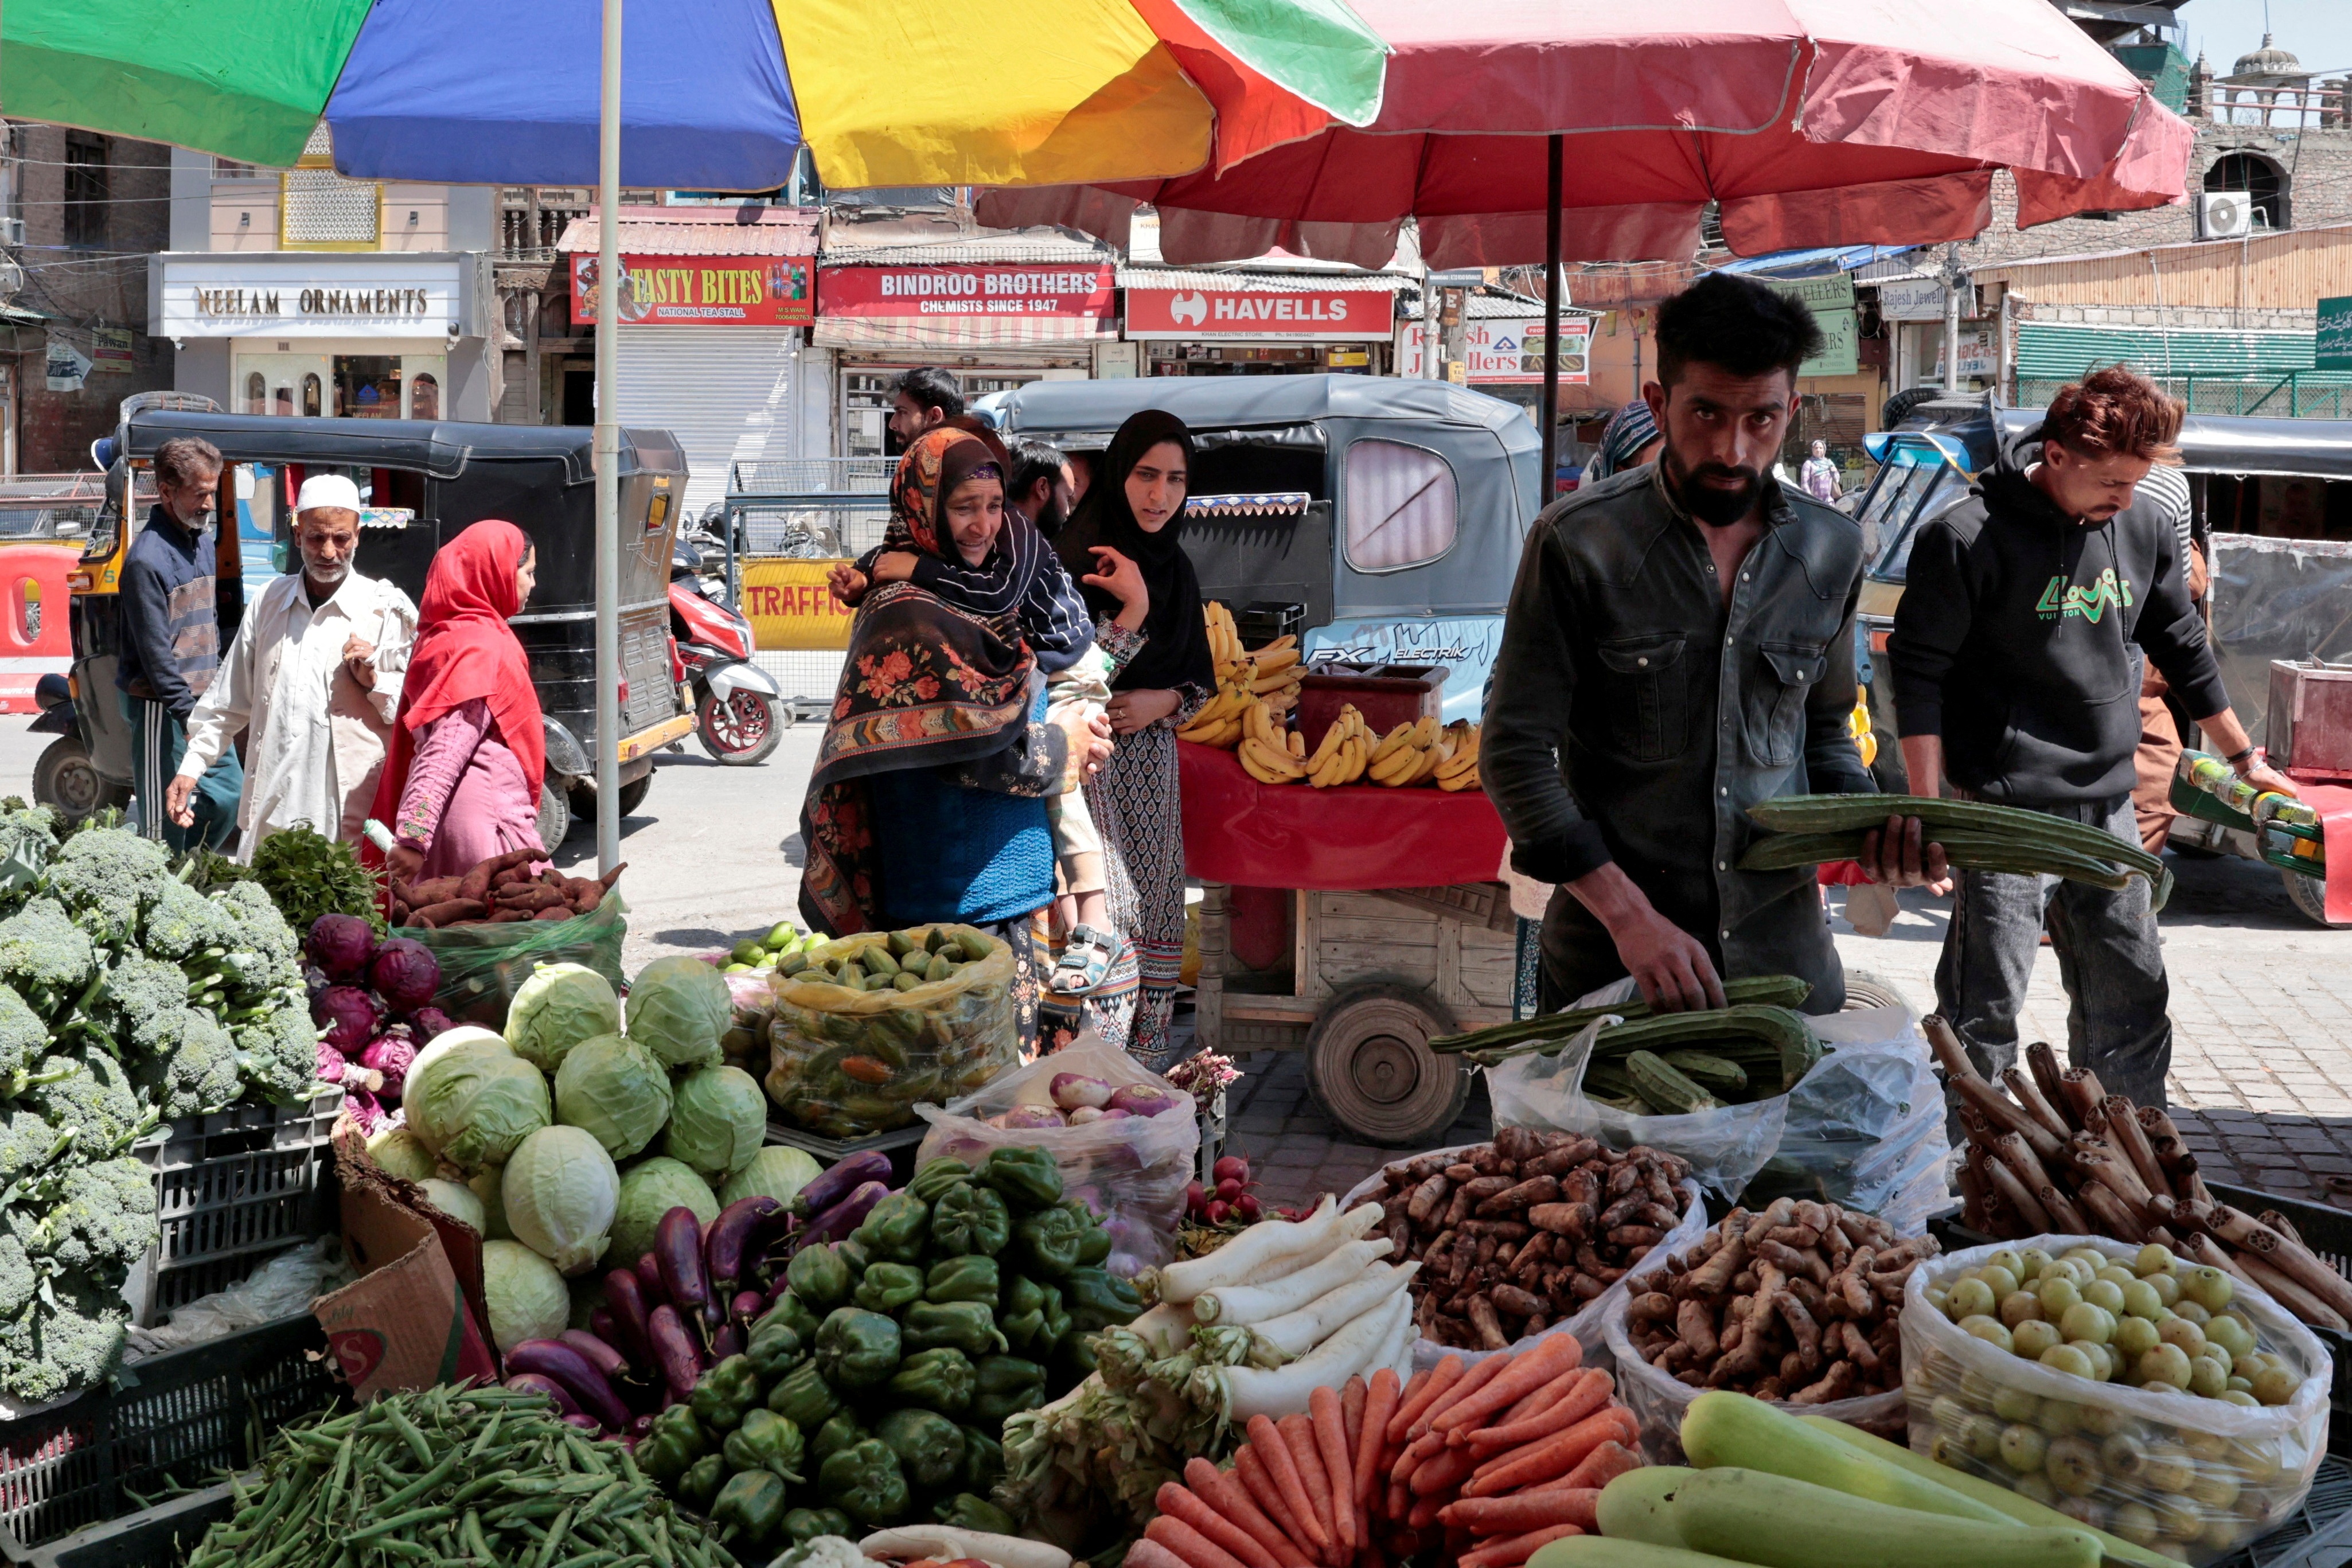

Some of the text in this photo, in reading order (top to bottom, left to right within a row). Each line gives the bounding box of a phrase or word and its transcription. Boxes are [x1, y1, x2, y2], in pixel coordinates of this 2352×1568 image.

[630, 268, 763, 305] TASTY BITES
[881, 272, 1097, 296] BINDROO BROTHERS
[194, 286, 427, 317] NEELAM ORNAMENTS
[920, 299, 1058, 313] CHEMISTS SINCE 1947
[1215, 298, 1347, 321] HAVELLS
[1446, 293, 1457, 309] E
[1884, 287, 1947, 310] Rajesh Jewell
[657, 307, 746, 317] NATIONAL TEA STALL
[1409, 352, 1518, 374] Jllers
[2038, 609, 2080, 620] VUITON
[1394, 646, 1469, 660] ELECTRIK
